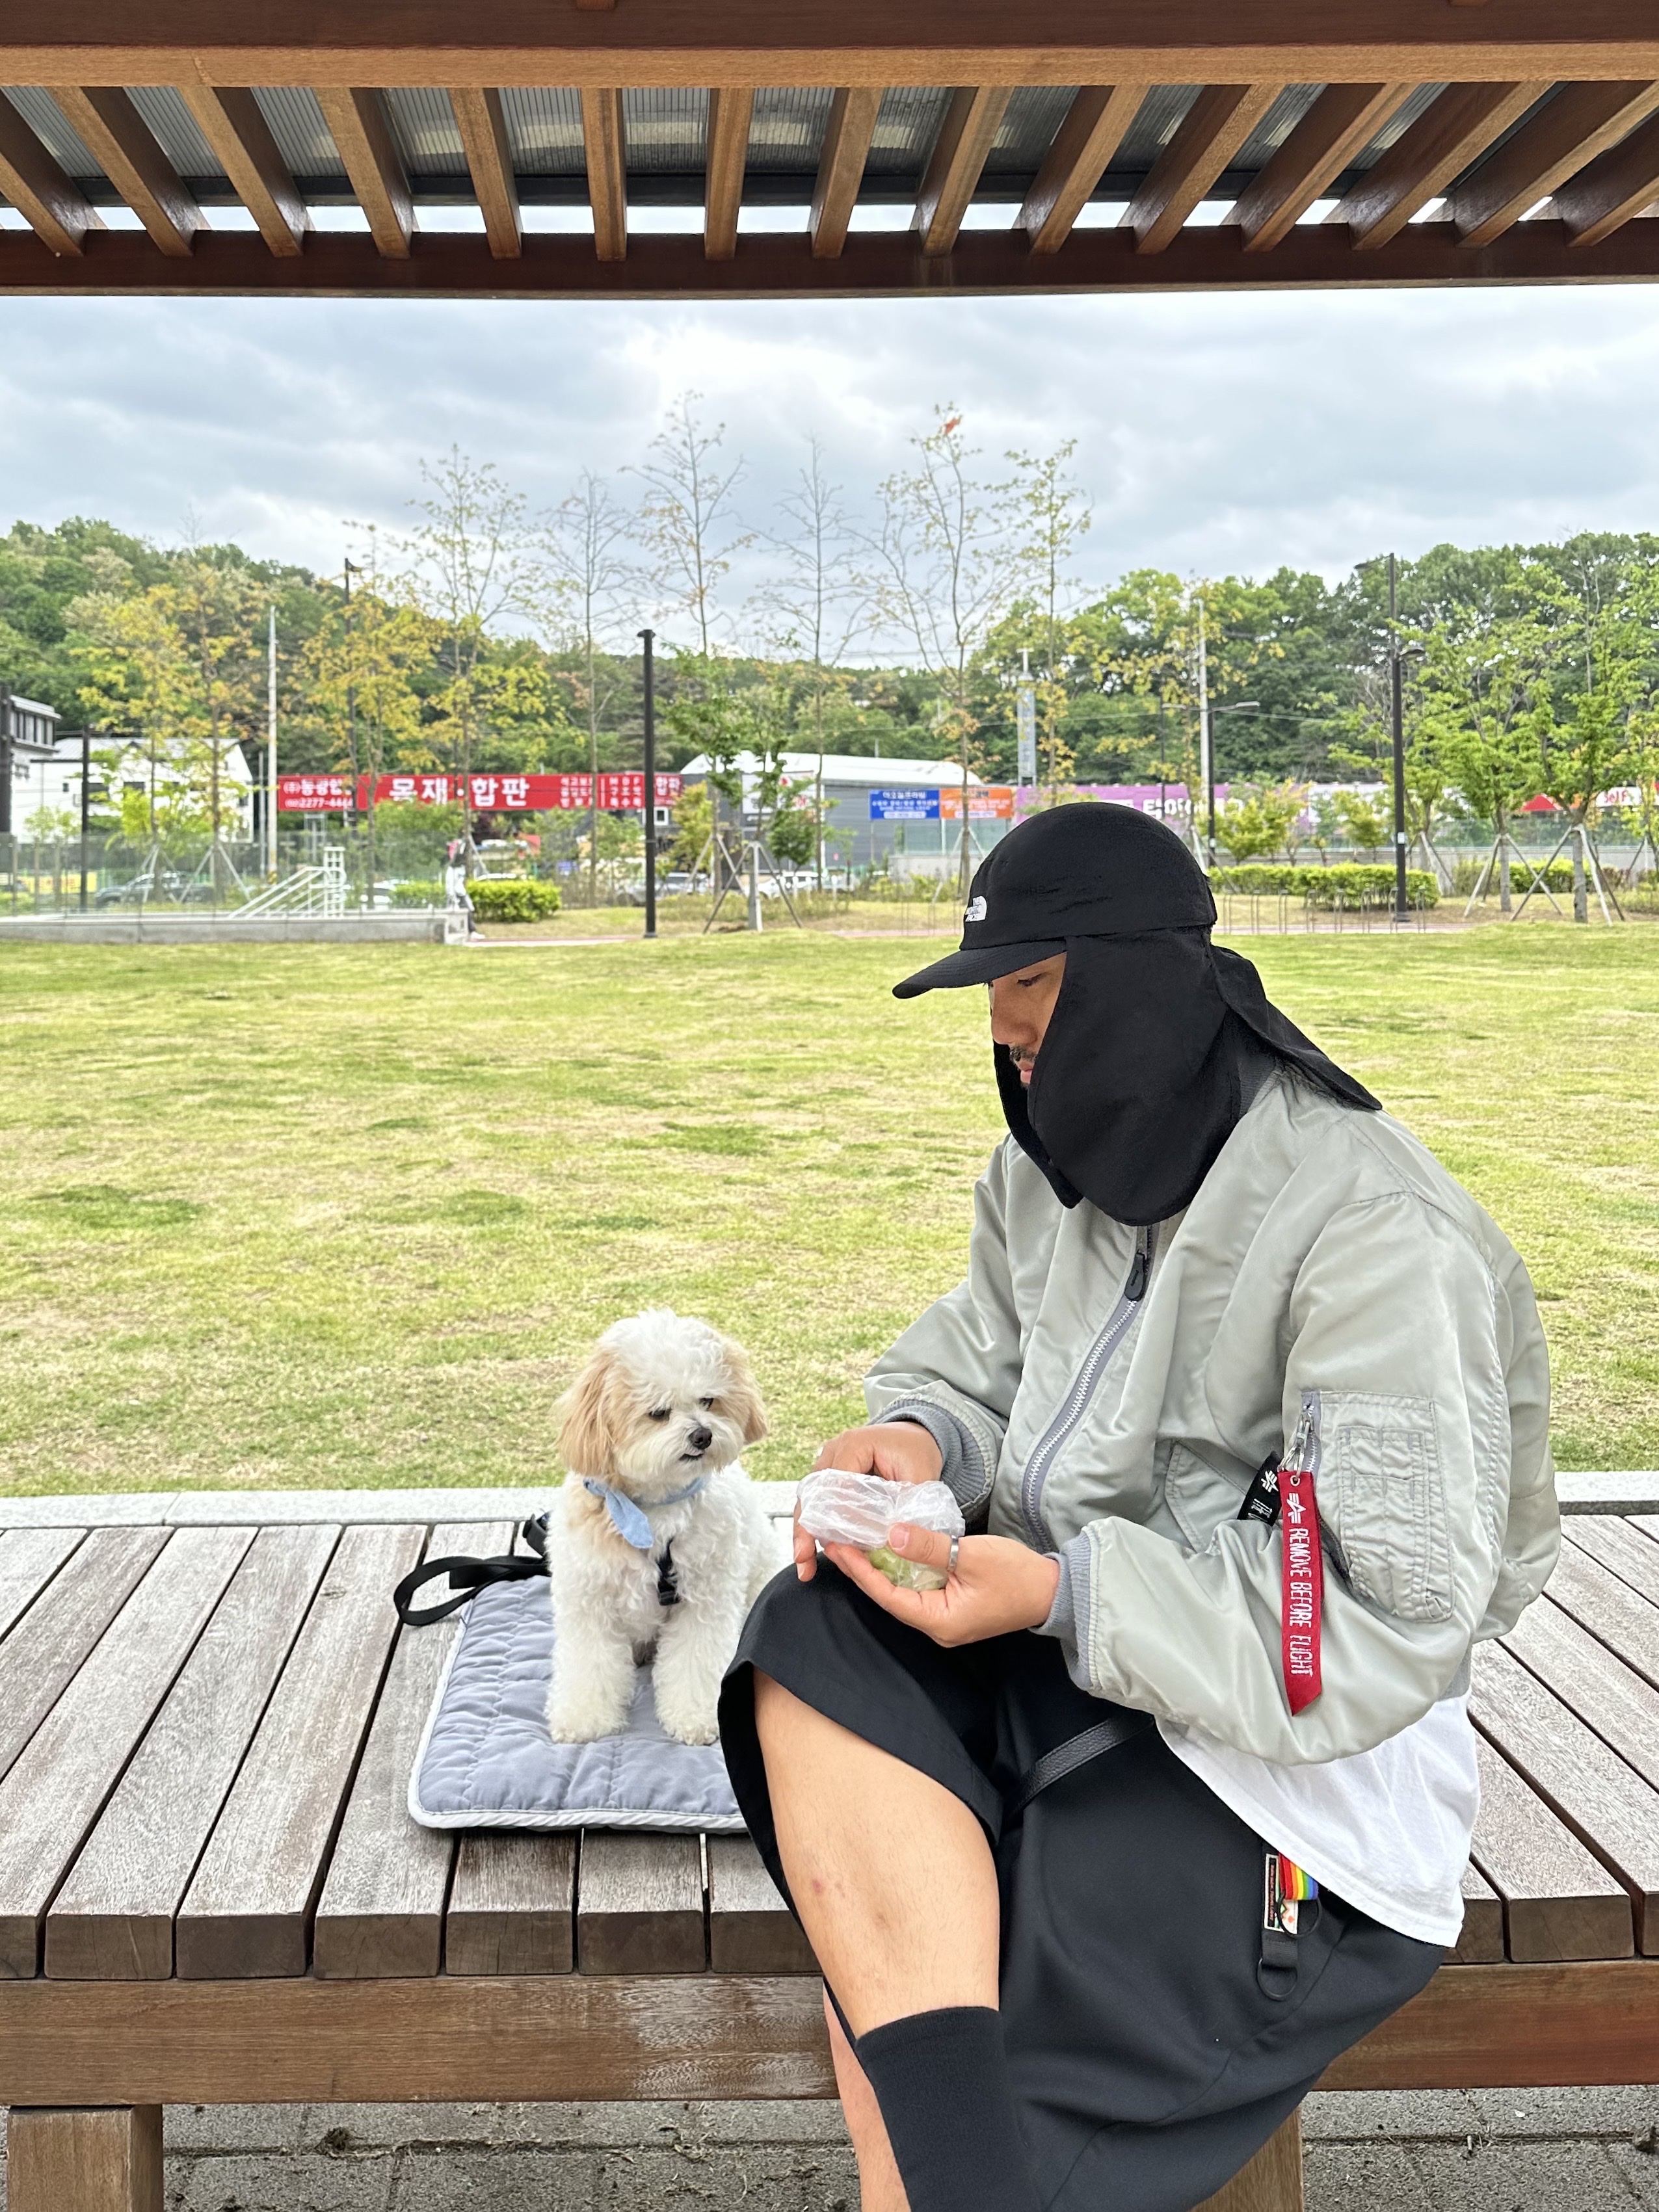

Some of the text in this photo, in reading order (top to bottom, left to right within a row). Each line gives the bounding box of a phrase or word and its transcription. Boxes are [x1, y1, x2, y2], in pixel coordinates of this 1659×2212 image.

[1289, 1528, 1313, 1677] REMOVE BEFORE FLIGHT
